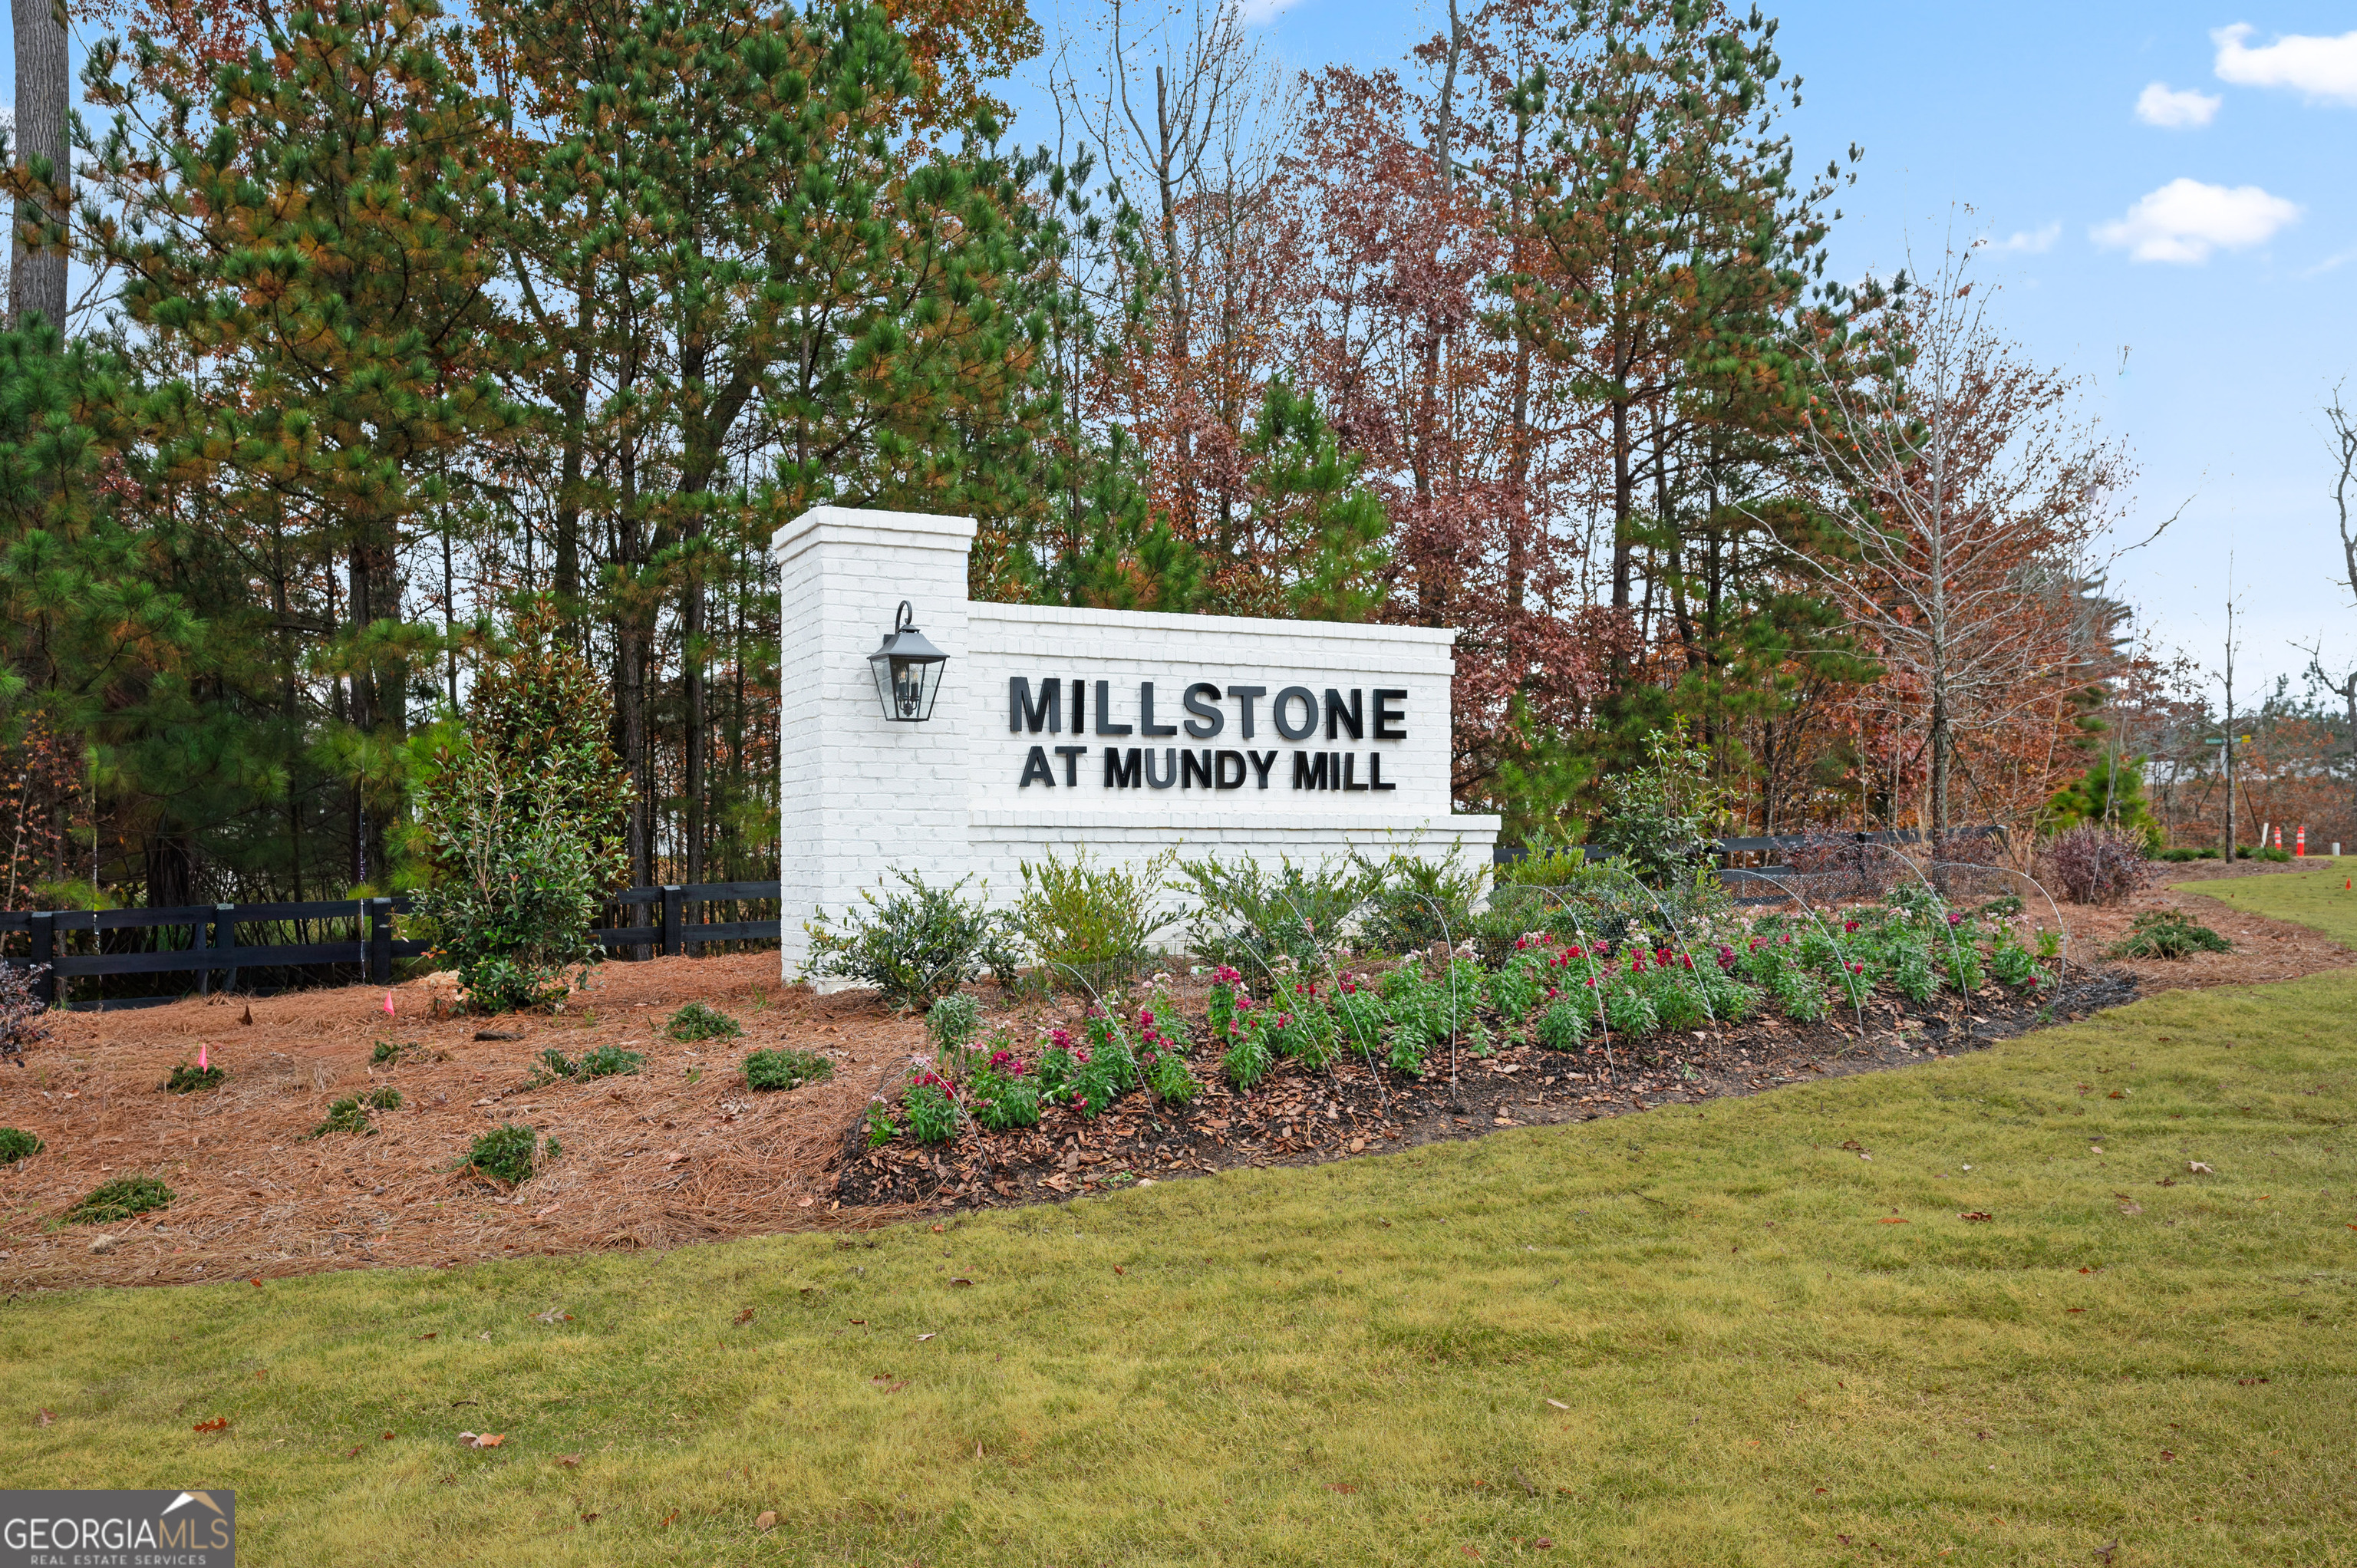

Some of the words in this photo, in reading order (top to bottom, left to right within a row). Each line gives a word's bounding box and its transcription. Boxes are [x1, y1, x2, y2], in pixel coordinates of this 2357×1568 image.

[1010, 676, 1408, 740] MILLSTONE
[1020, 746, 1087, 787] AT
[1104, 746, 1278, 789] MUNDY
[1293, 750, 1396, 791] MILL
